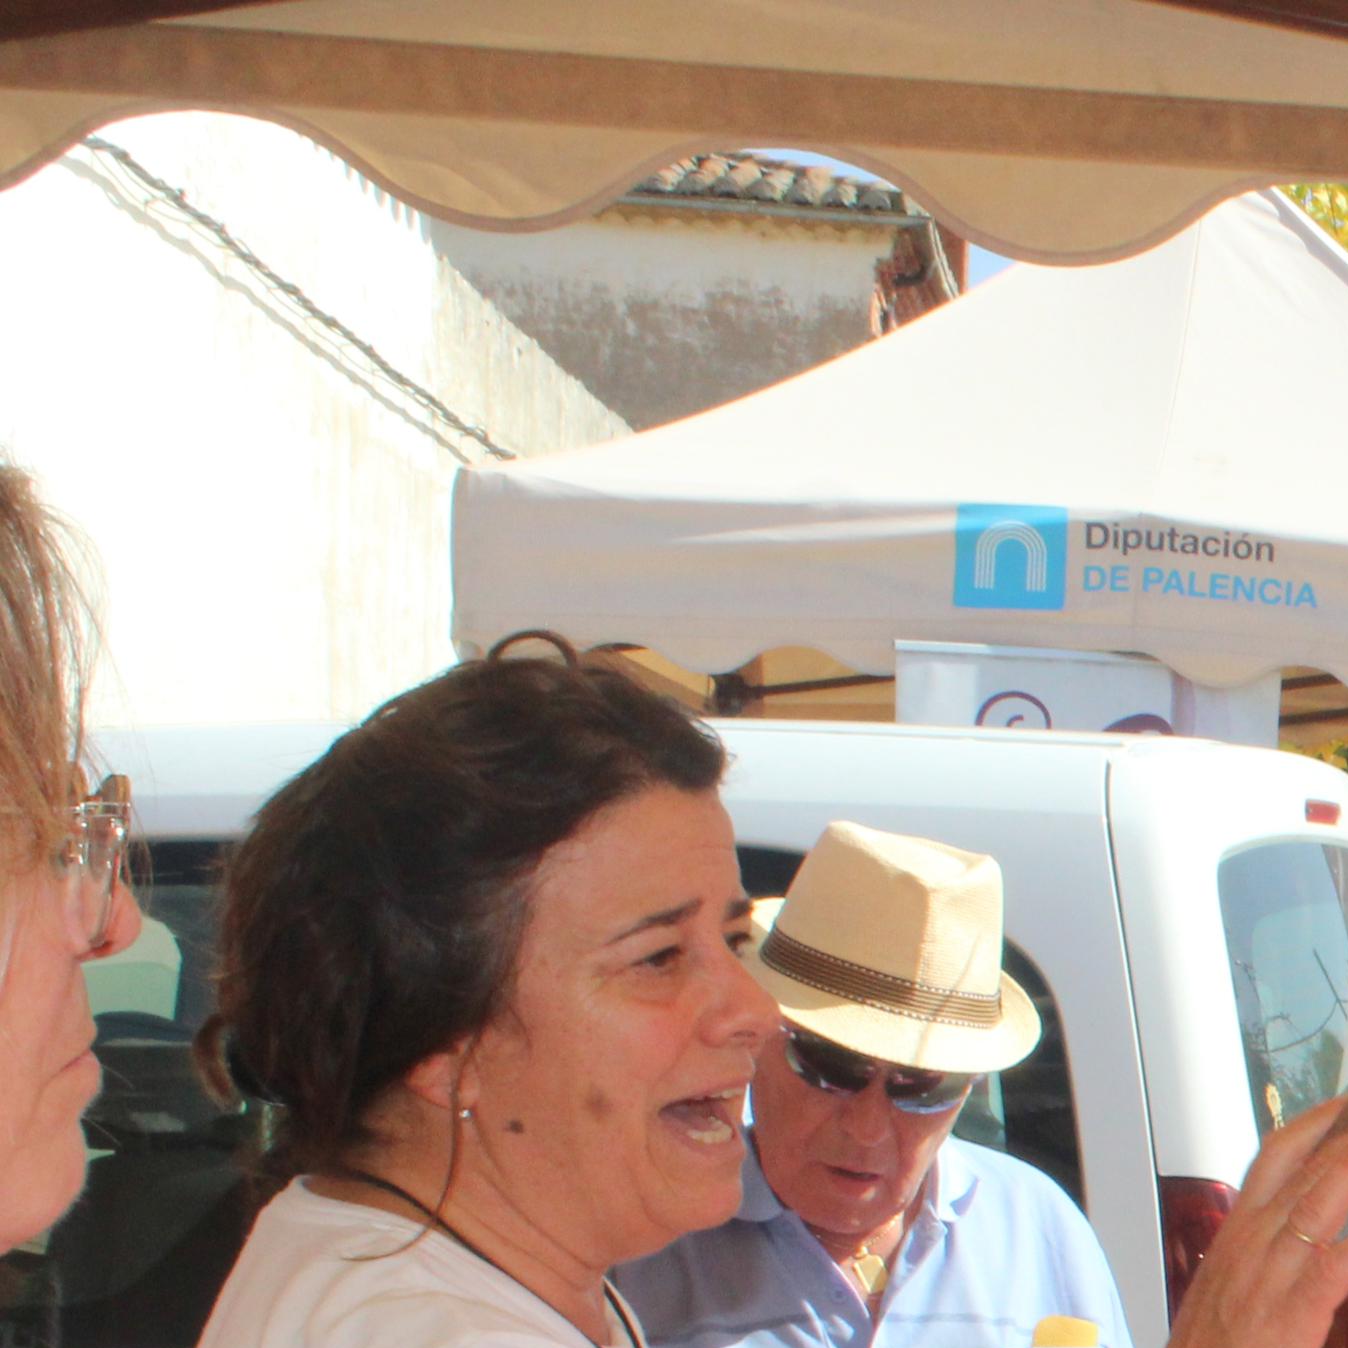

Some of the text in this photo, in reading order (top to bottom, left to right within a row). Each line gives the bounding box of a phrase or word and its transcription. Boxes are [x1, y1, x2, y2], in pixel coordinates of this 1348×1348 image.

[1084, 521, 1276, 562] Diputación
[1083, 565, 1318, 608] DE PALENCIA
